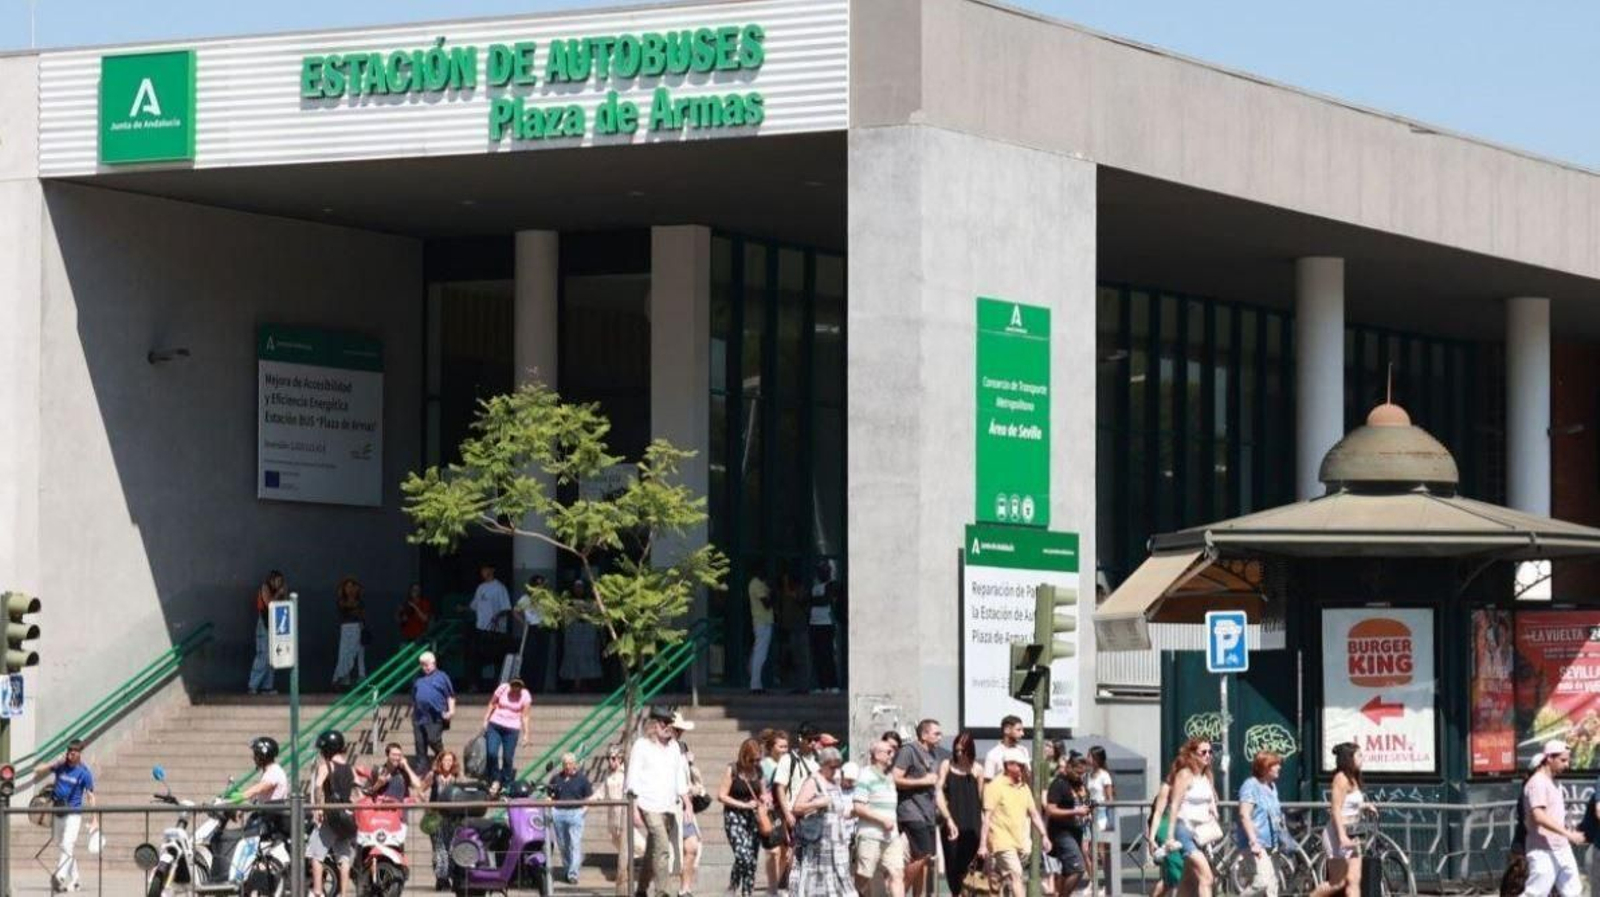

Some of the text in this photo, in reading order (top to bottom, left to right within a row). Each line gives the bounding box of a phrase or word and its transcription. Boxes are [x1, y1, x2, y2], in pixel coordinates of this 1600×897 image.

[300, 24, 765, 99] ESTACIÓN DE AUTOBUSES
[489, 87, 765, 141] Plaza de Armas
[110, 121, 132, 131] Junta
[133, 120, 143, 130] de
[265, 374, 353, 392] Mejora de Accesibilidad
[1011, 379, 1018, 391] de
[1019, 380, 1047, 396] Transporte
[264, 395, 270, 406] y
[271, 393, 307, 408] Eficiencia
[299, 414, 315, 427] BUS
[341, 419, 350, 429] de
[988, 418, 1042, 440] Área de Sevilla
[972, 581, 1014, 598] Reparación
[1015, 584, 1025, 598] de
[972, 605, 979, 619] la
[981, 604, 1013, 620] Estación
[1014, 606, 1024, 621] de
[972, 629, 993, 644] Plaza
[994, 630, 1004, 644] de
[1215, 619, 1242, 666] P
[1546, 627, 1584, 641] VUELTA
[1348, 639, 1412, 654] BURGER
[1348, 653, 1413, 675] KING
[1365, 734, 1414, 751] MIN.
